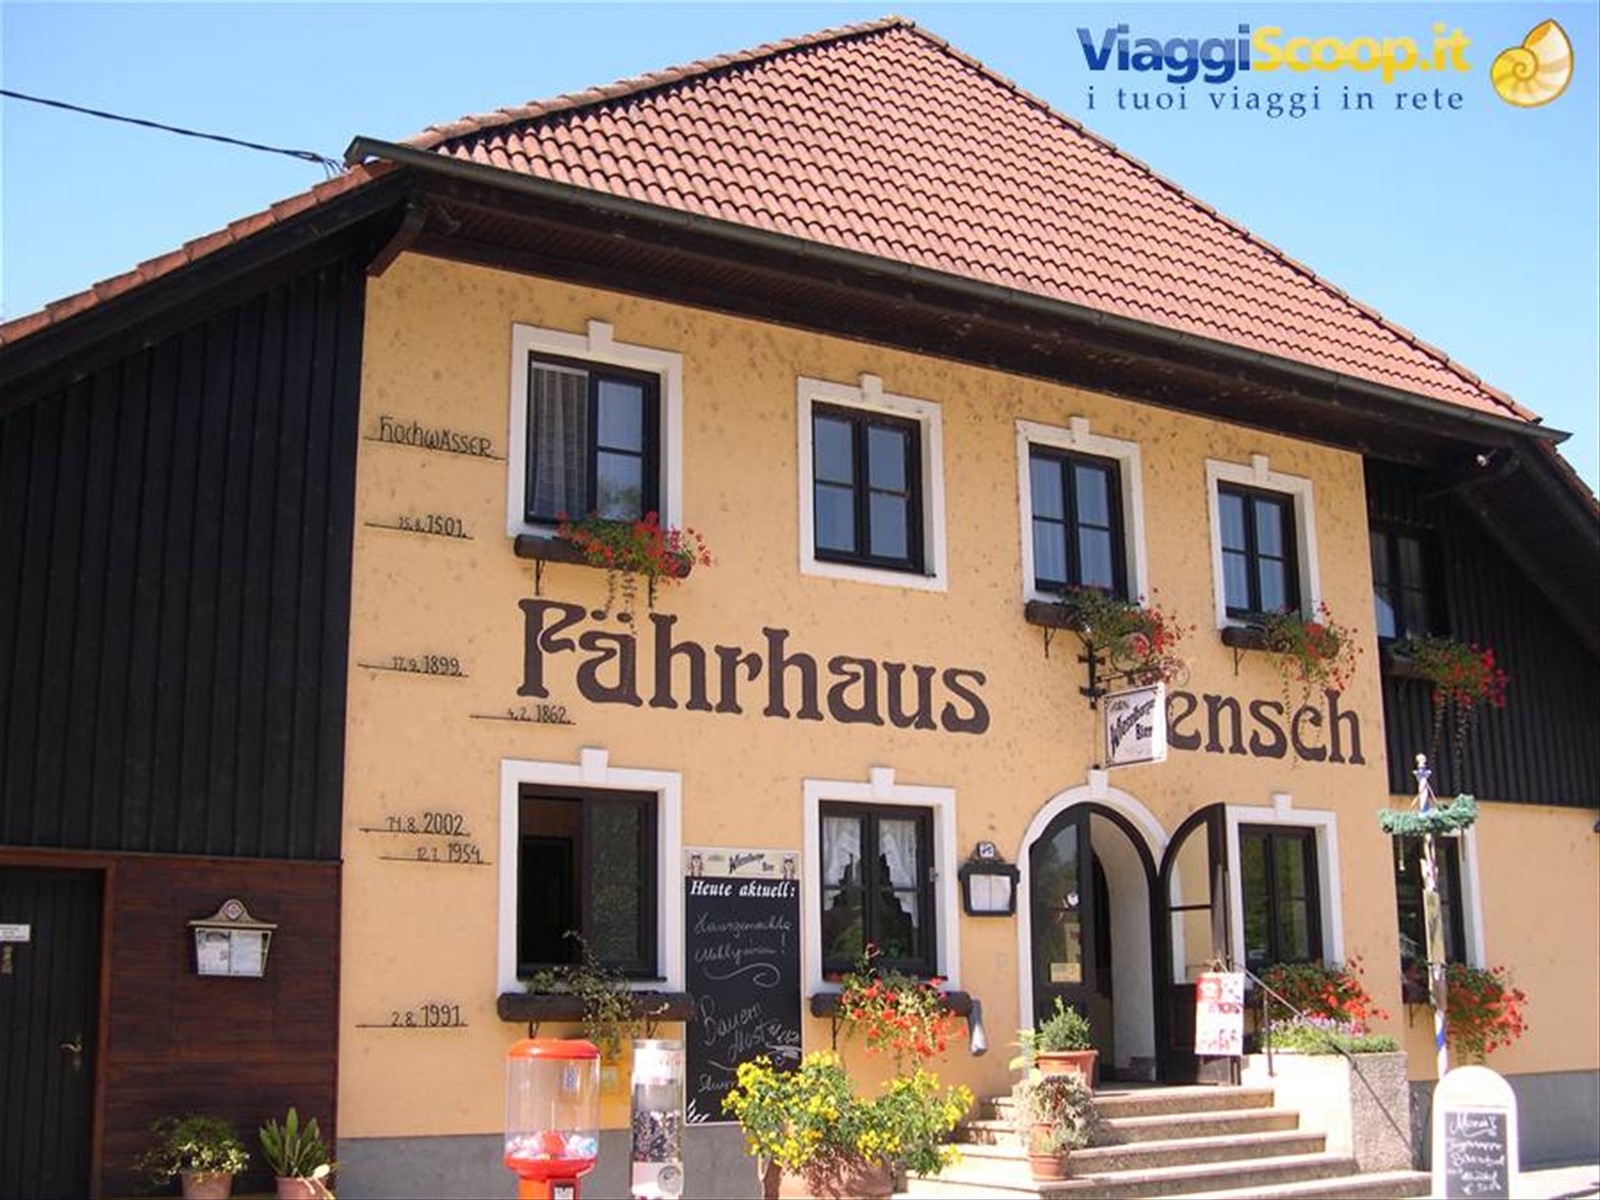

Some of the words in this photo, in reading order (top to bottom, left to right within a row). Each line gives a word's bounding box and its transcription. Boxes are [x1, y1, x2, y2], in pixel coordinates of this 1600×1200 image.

[517, 598, 990, 735] Fährhaus
[690, 880, 733, 897] Heute
[739, 880, 796, 898] aktuell:
